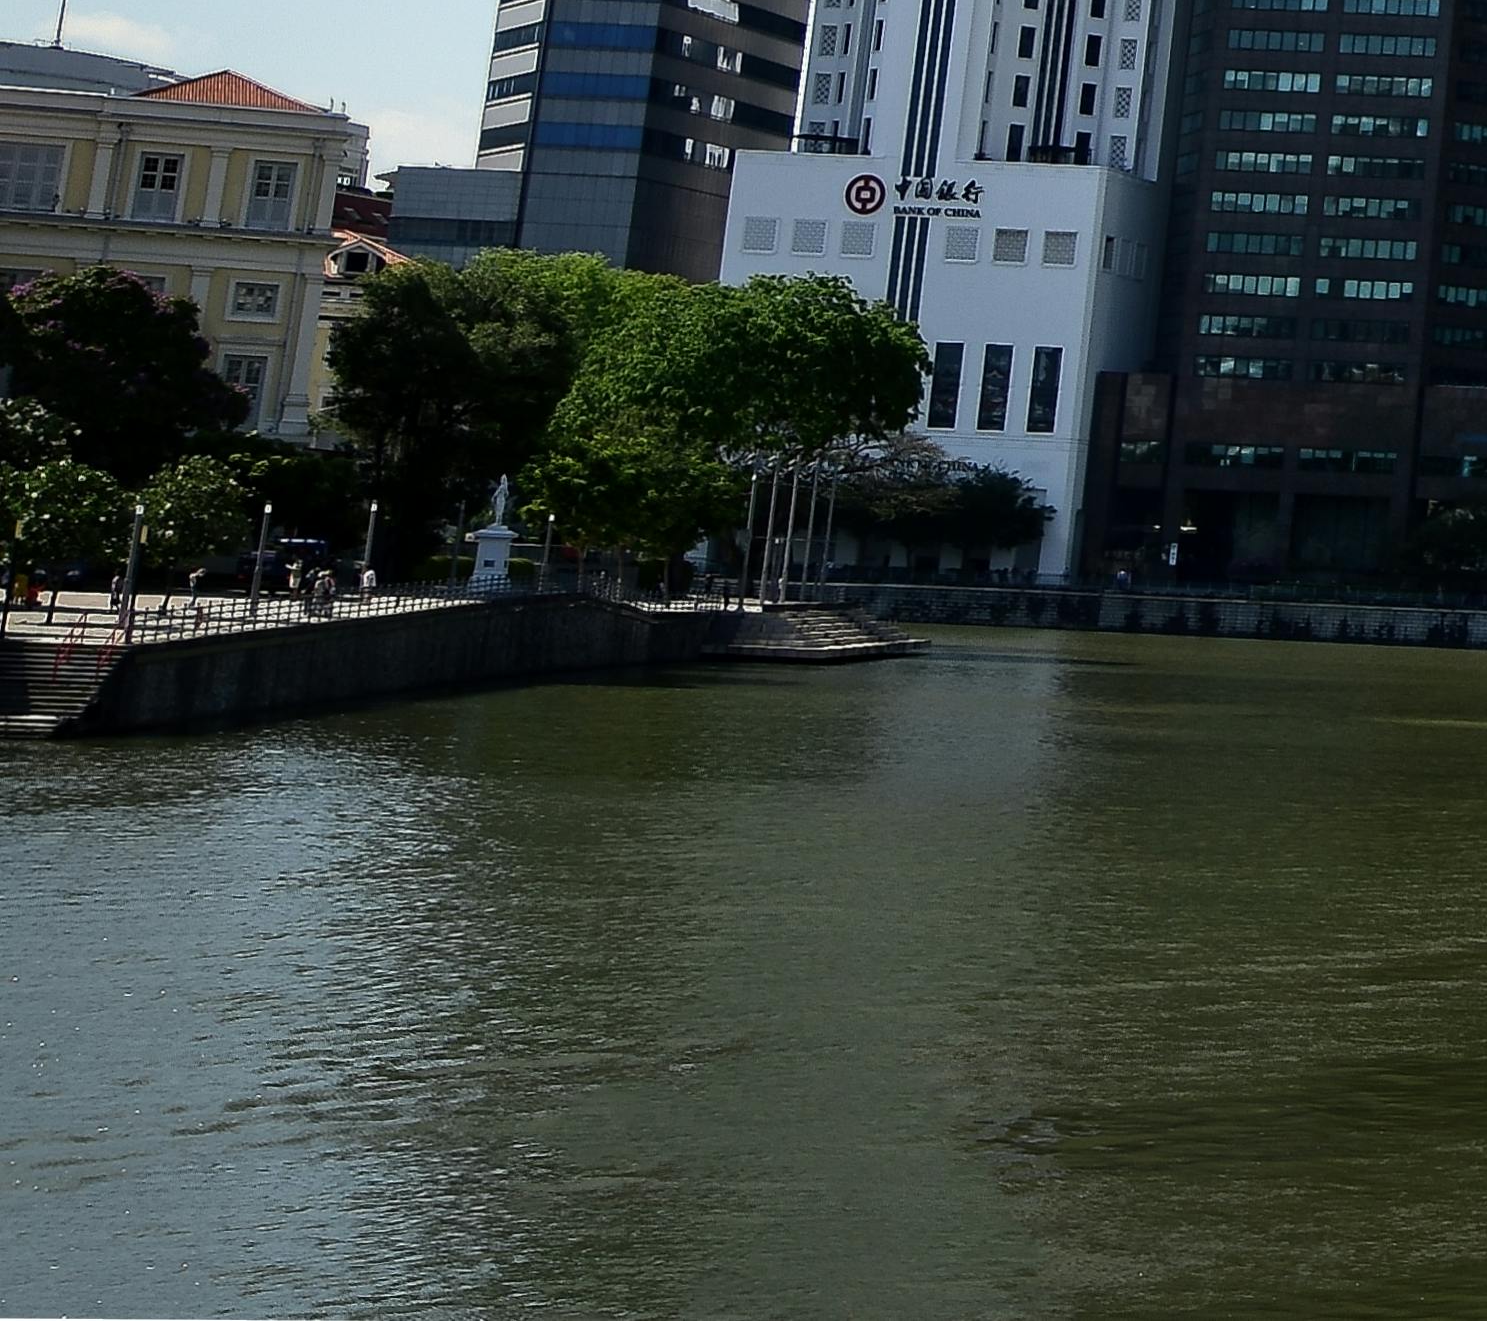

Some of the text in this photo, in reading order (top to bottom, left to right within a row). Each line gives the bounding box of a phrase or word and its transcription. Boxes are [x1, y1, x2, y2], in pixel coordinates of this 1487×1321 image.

[893, 206, 982, 219] BANK OF CHINA
